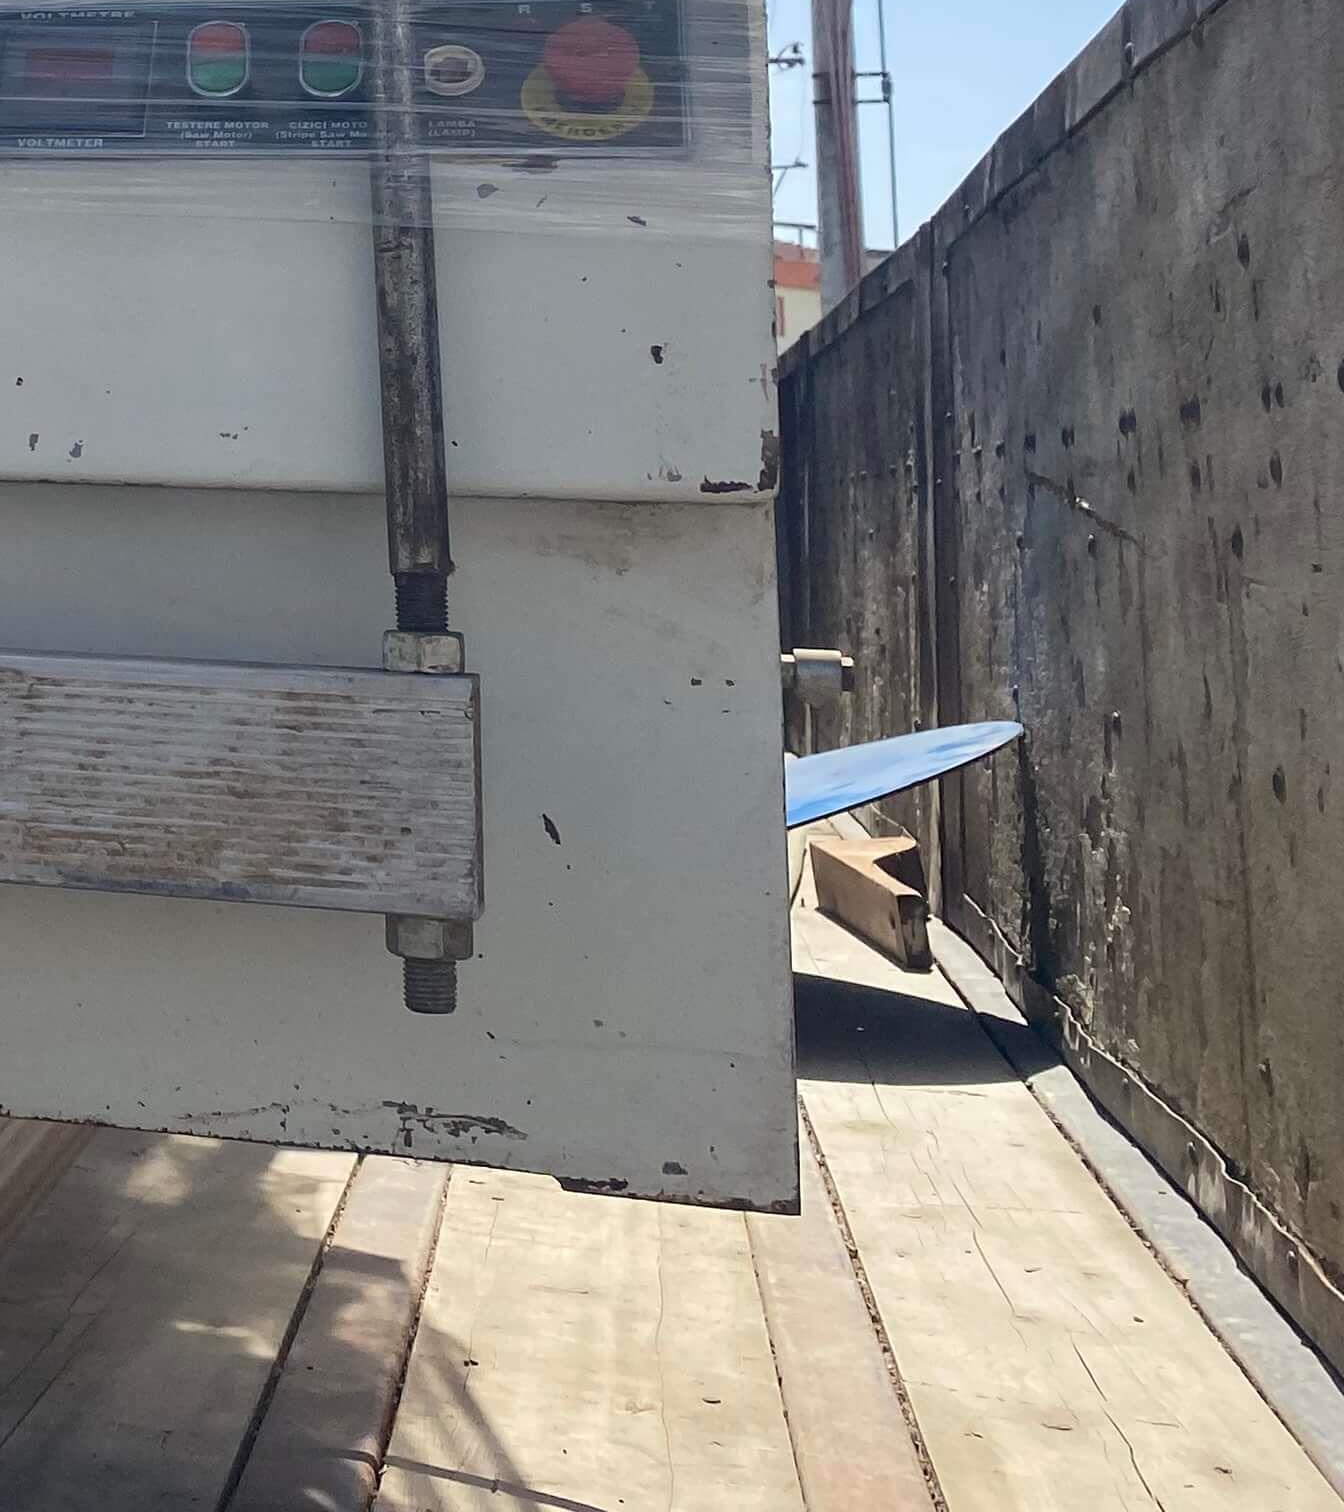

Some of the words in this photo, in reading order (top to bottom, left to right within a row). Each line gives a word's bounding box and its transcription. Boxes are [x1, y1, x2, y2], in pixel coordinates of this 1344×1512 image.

[166, 121, 221, 130] TESTERE
[223, 121, 269, 130] MOTOR
[17, 138, 104, 149] VOLTMETER
[195, 140, 236, 148] START
